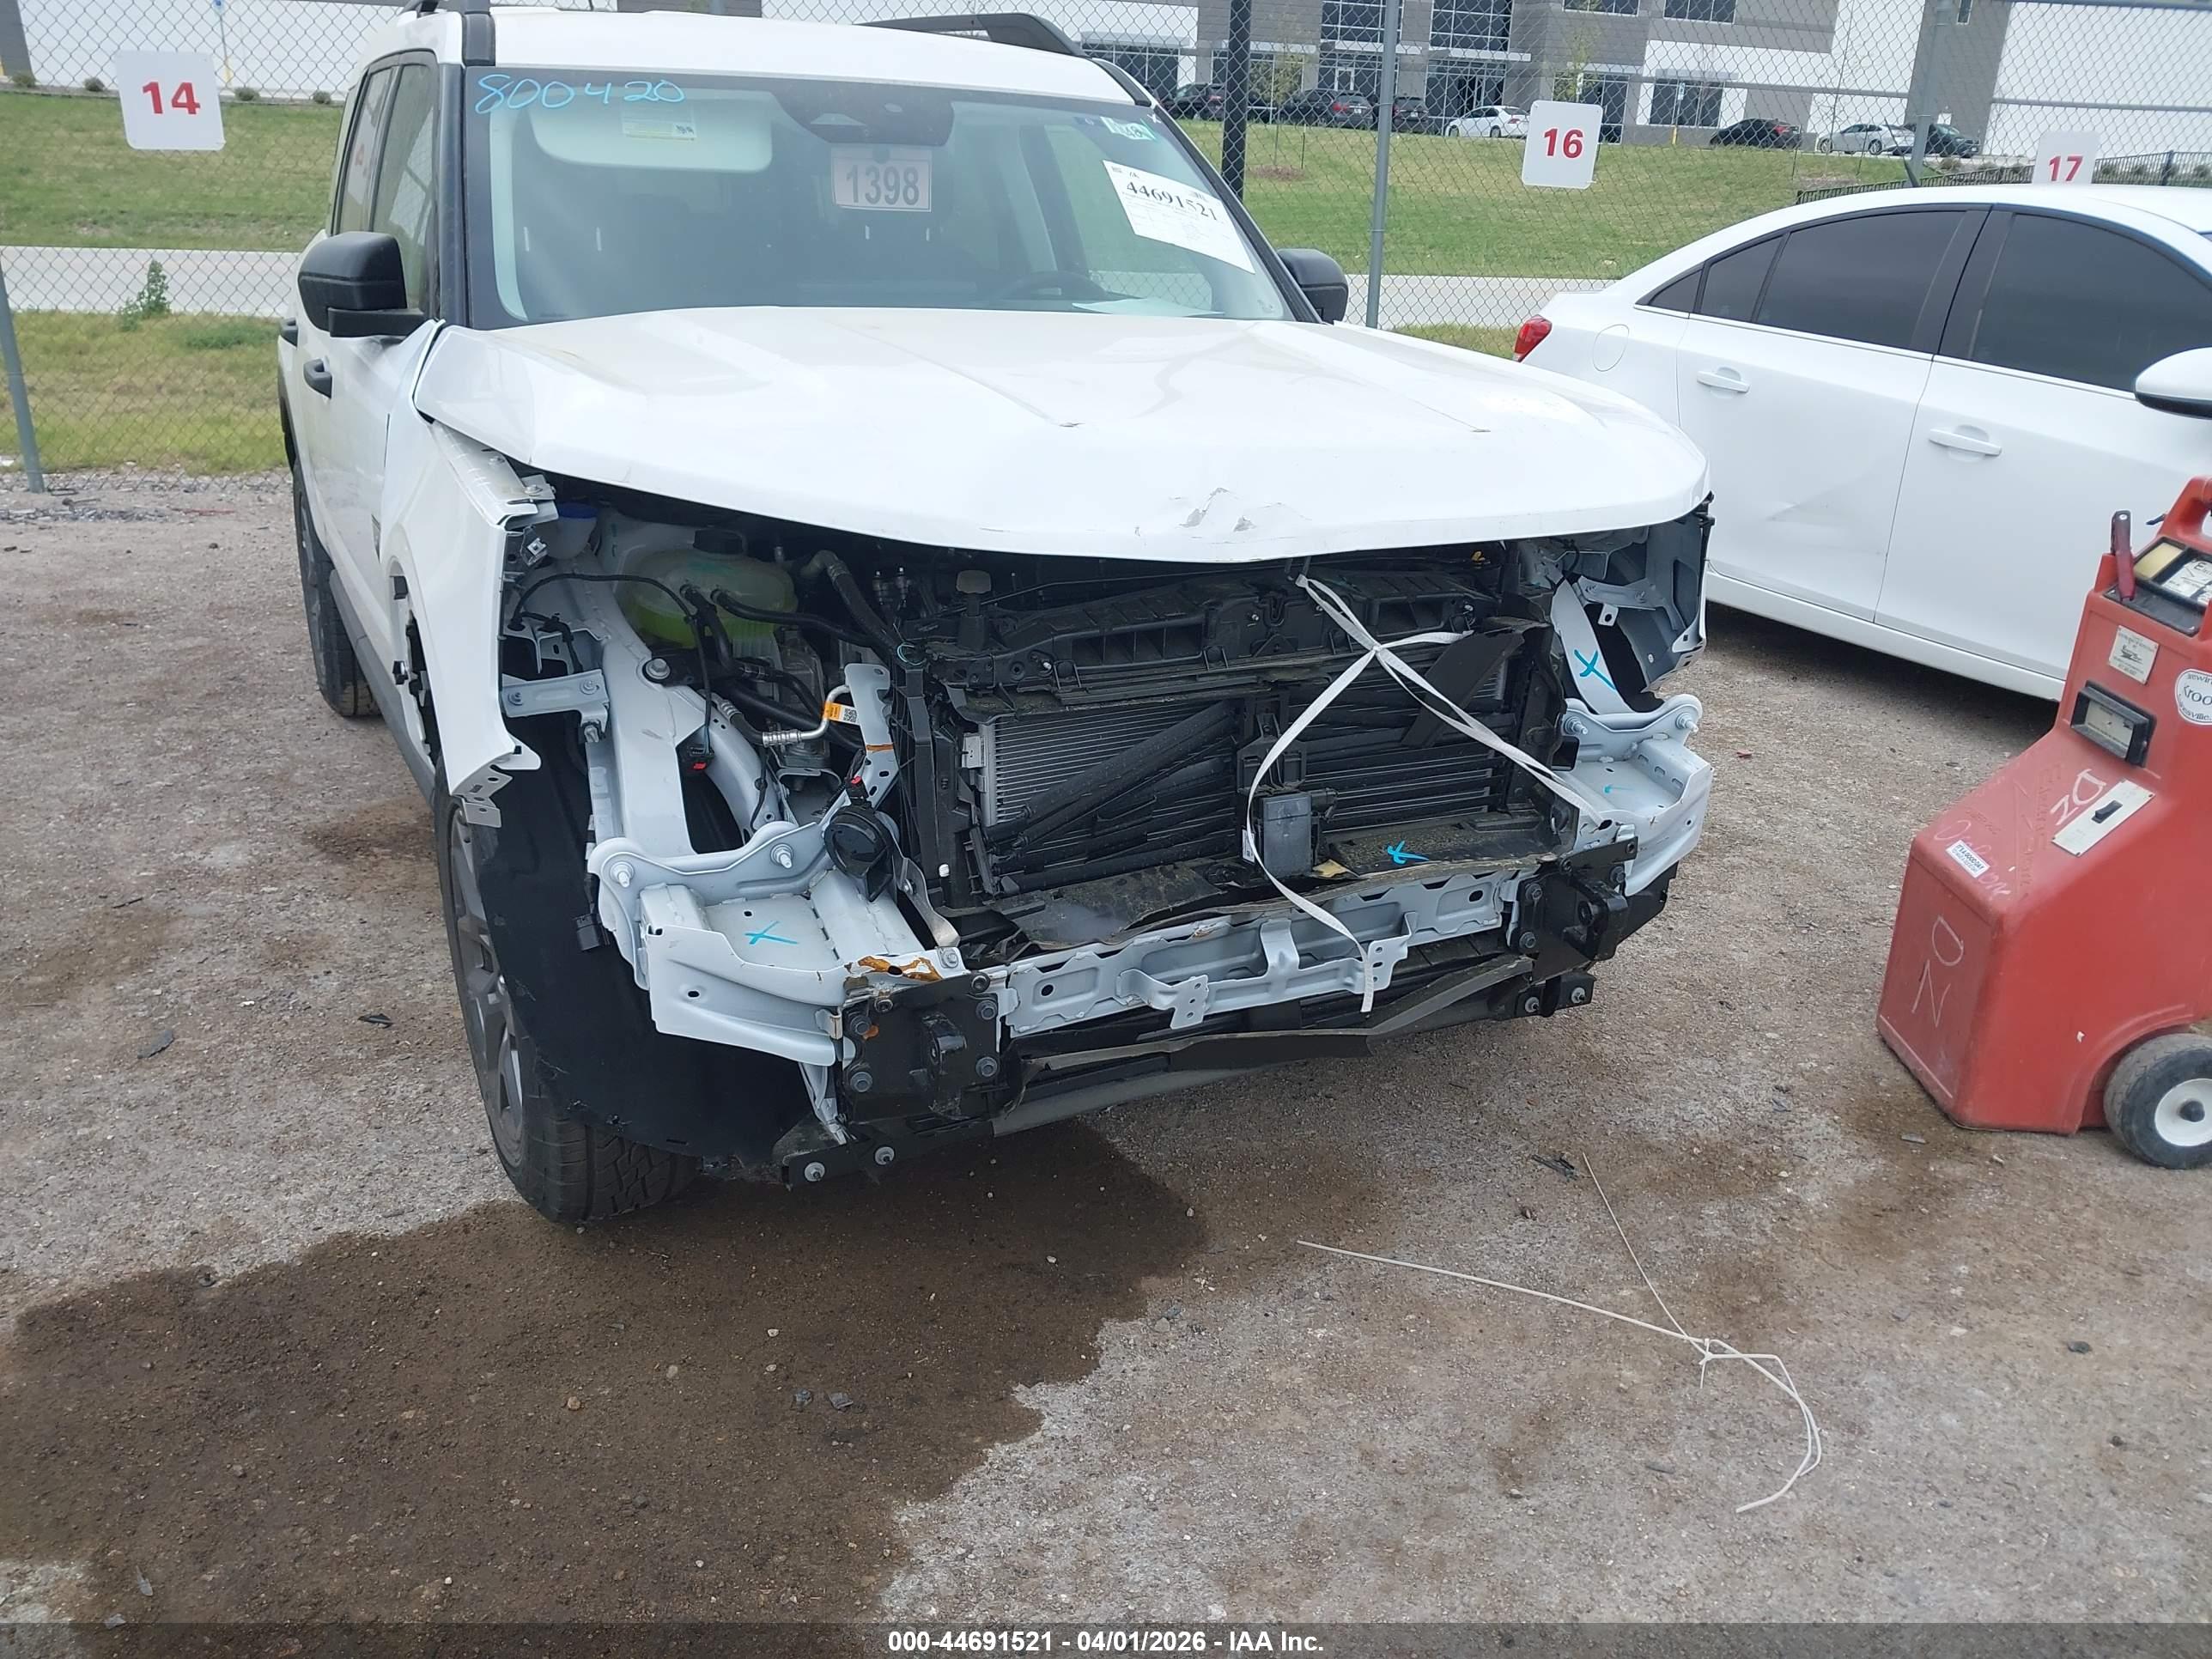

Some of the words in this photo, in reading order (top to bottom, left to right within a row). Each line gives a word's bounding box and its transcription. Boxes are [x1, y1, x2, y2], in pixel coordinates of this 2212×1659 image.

[141, 81, 202, 115] 14
[474, 74, 686, 114] 800420
[1543, 127, 1585, 160] 16
[845, 164, 920, 206] 1398
[2048, 155, 2084, 182] 17
[1126, 180, 1218, 221] 44691521
